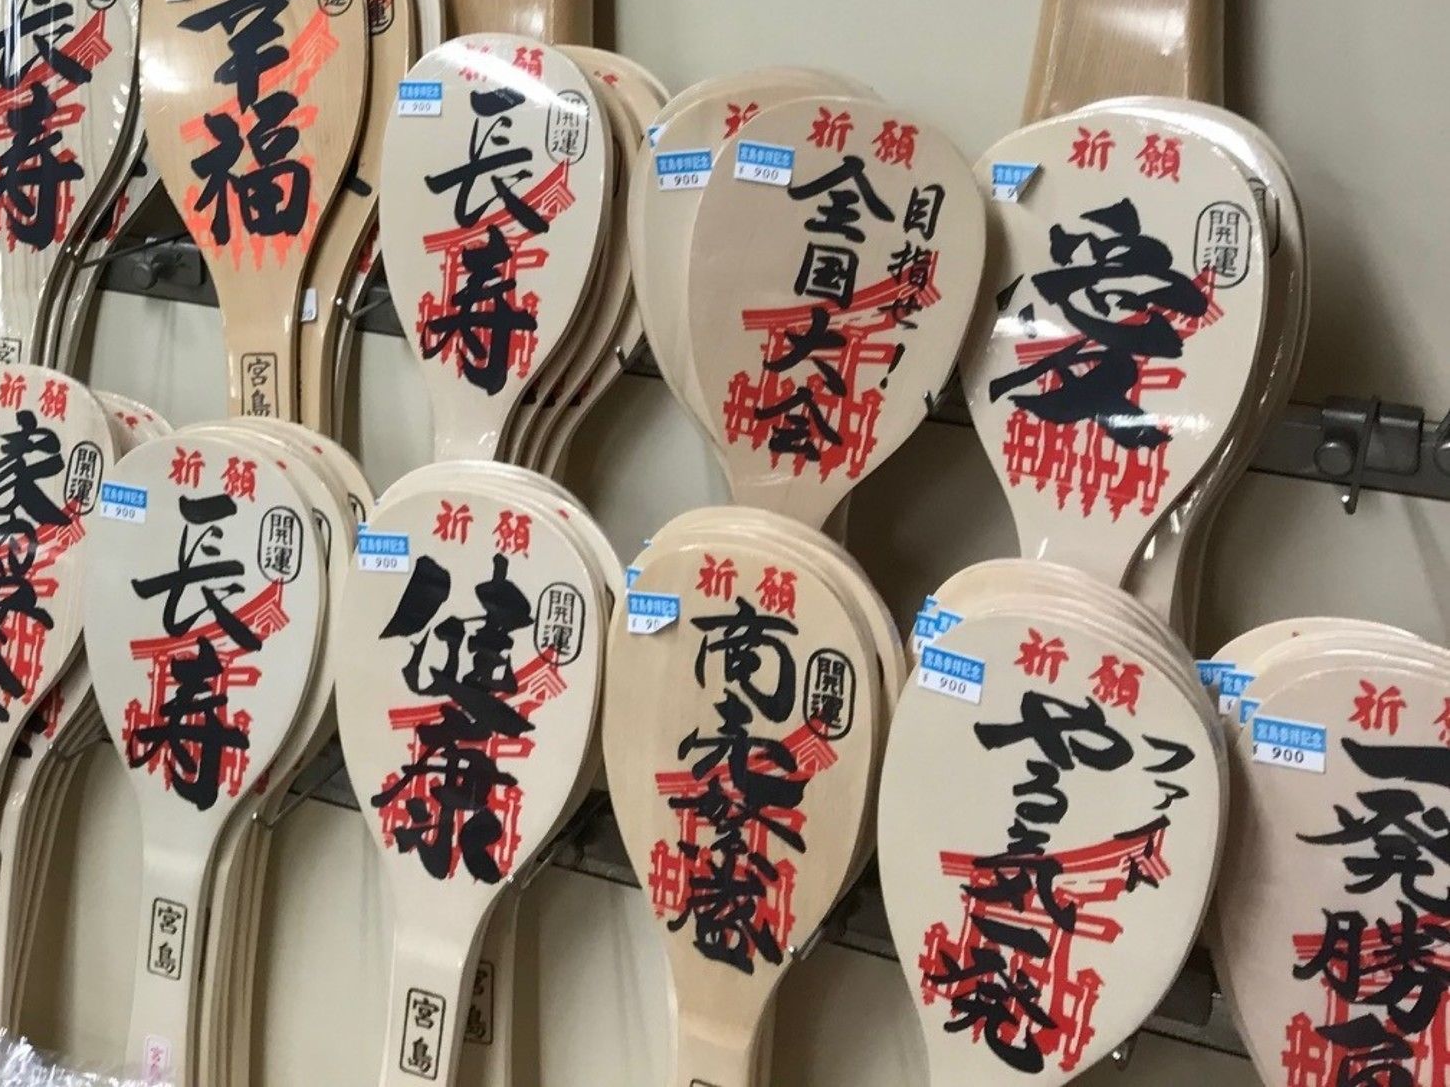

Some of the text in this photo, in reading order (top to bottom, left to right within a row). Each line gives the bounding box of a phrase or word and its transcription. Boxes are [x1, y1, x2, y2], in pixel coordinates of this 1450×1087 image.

[412, 102, 432, 112] 900
[806, 106, 920, 170] 祈願
[674, 173, 699, 187] 900
[755, 168, 779, 180] 900
[1068, 126, 1185, 183] 祈願
[424, 90, 550, 396] 長寿
[755, 155, 894, 462] 全国大会
[990, 197, 1209, 450] 愛
[247, 358, 272, 416] 宮島
[168, 444, 258, 504] 祈願
[115, 507, 136, 520] 900
[432, 498, 534, 560] 祈願
[376, 558, 398, 570] 900
[694, 553, 800, 621] 祈願
[129, 493, 264, 811] 長寿
[923, 646, 985, 684] 宮島参拝記念
[1014, 628, 1145, 716] 祈願
[371, 552, 538, 886] 健康
[939, 679, 967, 696] 900
[1256, 719, 1324, 750] 宮島参拝記念
[1272, 747, 1305, 765] 900
[667, 596, 809, 976] 商売繁盛
[1114, 733, 1196, 894] ファイト
[924, 690, 1135, 1075] やる気一発
[155, 906, 181, 974] 宮島
[408, 997, 439, 1073] 宮島
